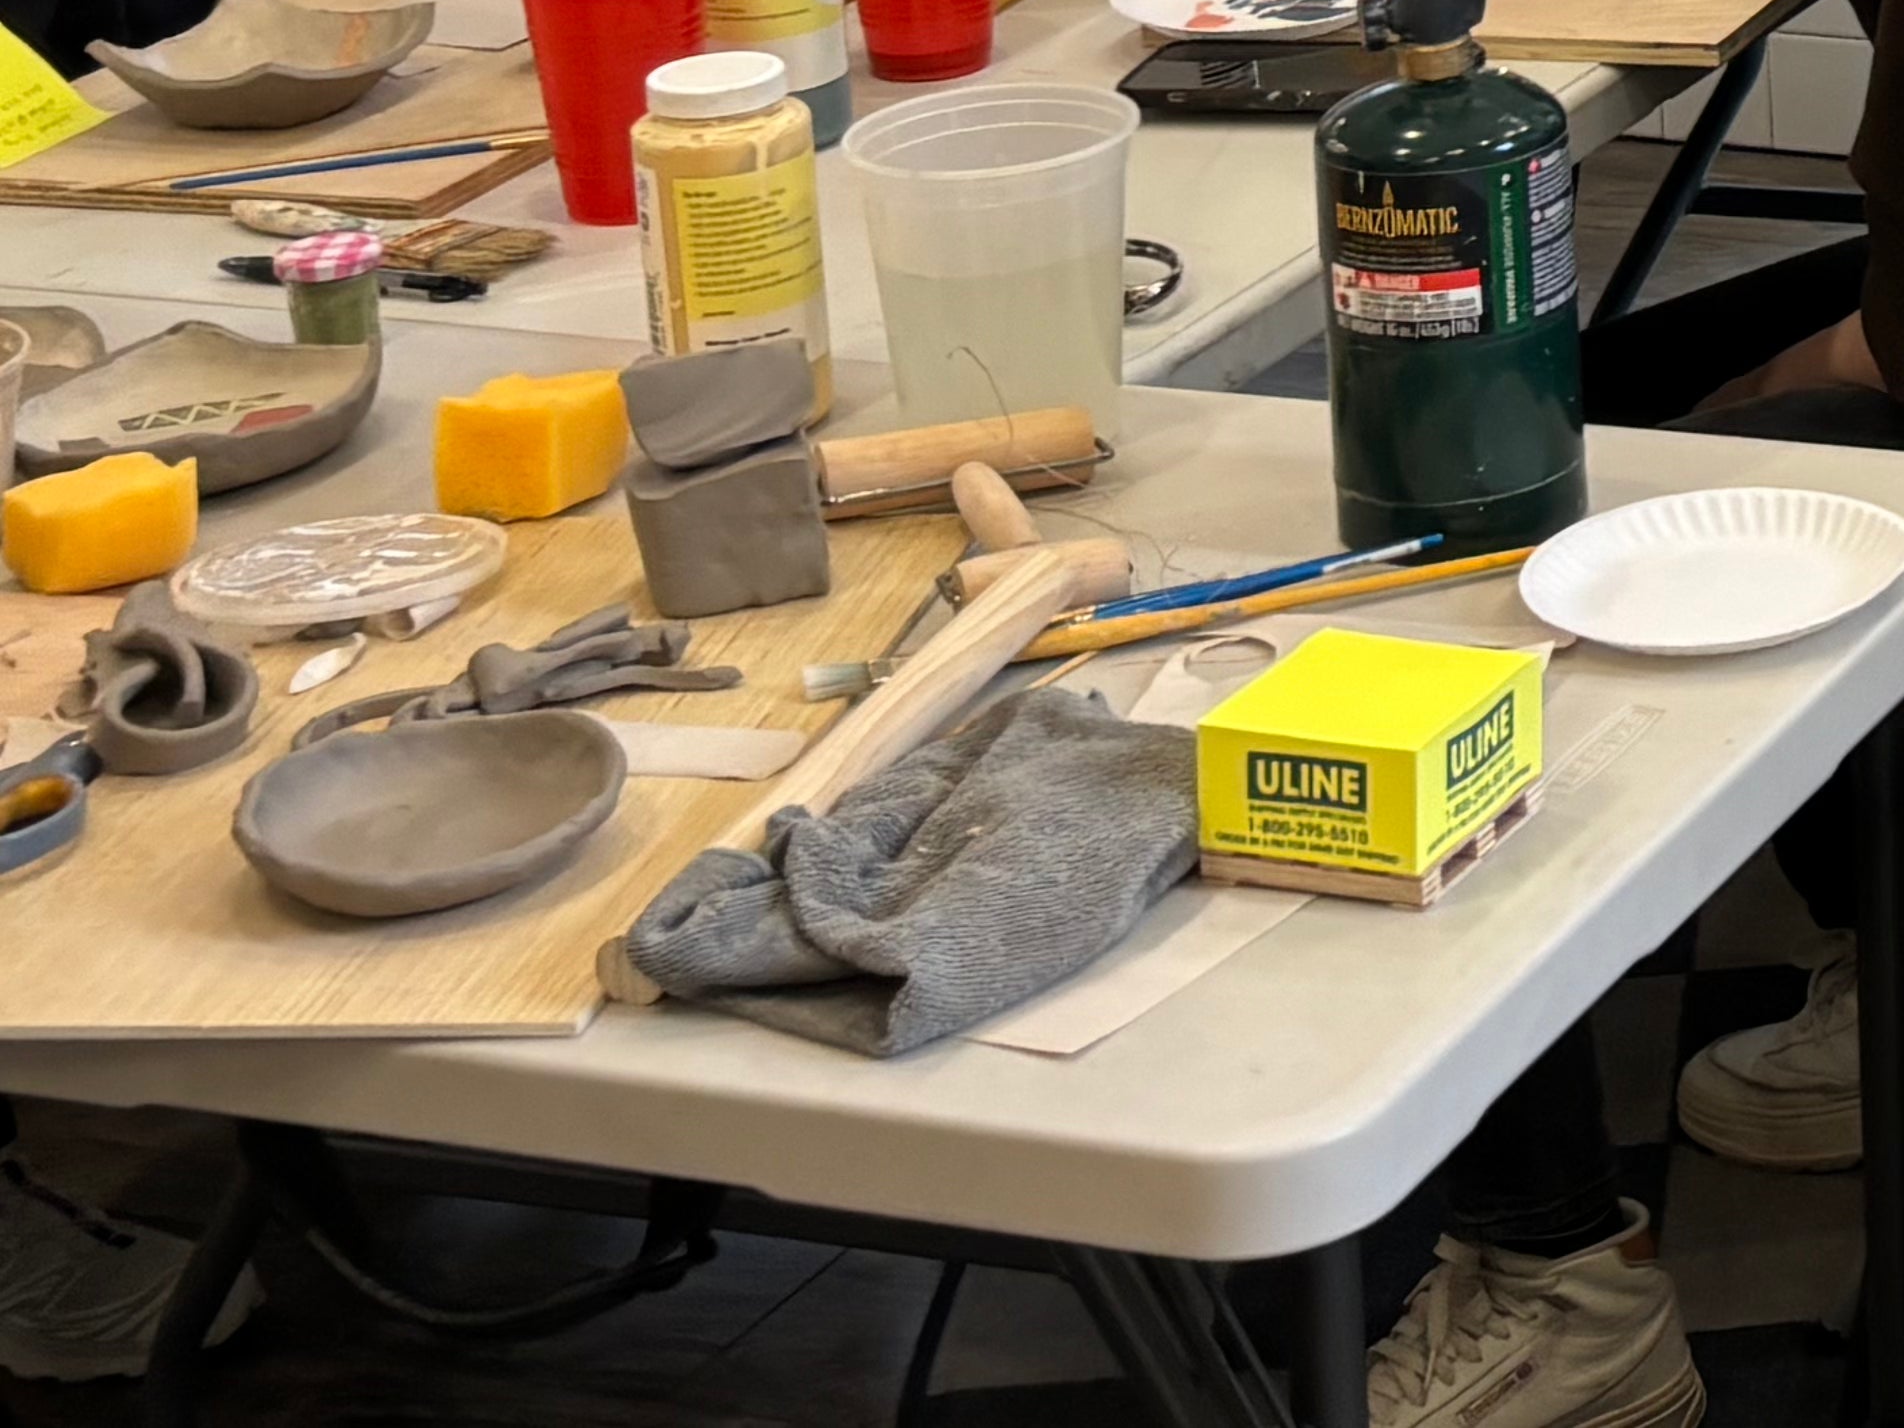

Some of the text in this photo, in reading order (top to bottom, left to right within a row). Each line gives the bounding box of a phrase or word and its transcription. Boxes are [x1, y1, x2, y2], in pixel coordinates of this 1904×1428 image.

[1335, 202, 1460, 238] BERNZOMATIC
[1451, 699, 1511, 779] ULINE
[1256, 759, 1360, 805] ULINE
